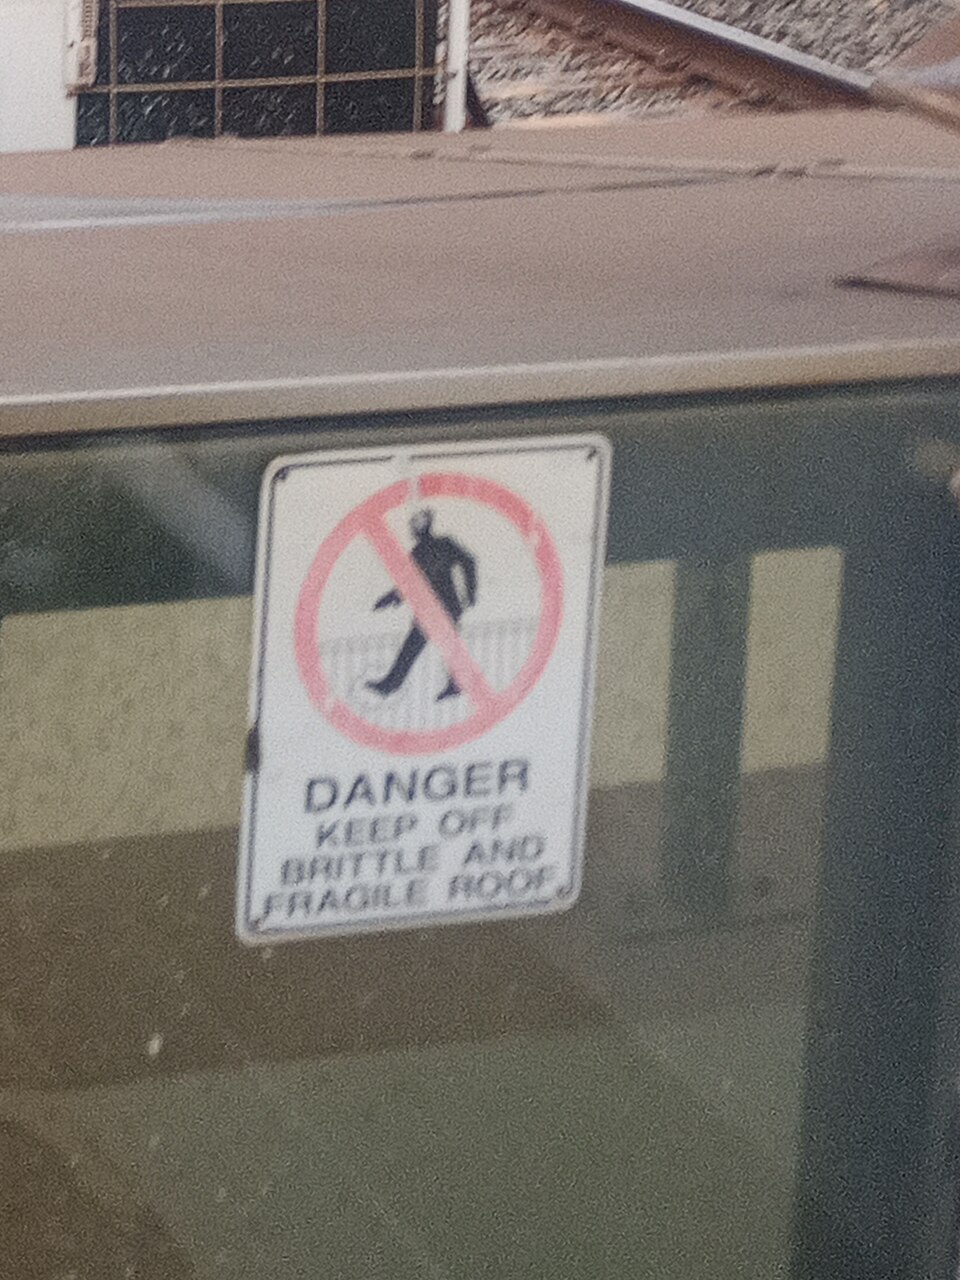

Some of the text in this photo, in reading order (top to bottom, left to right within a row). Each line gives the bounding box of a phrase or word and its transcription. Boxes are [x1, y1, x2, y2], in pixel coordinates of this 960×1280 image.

[303, 757, 531, 814] DANGER
[315, 802, 513, 848] KEEP OFF
[279, 834, 546, 886] BRITTLE AND
[262, 864, 559, 919] FRAGILE ROOF
